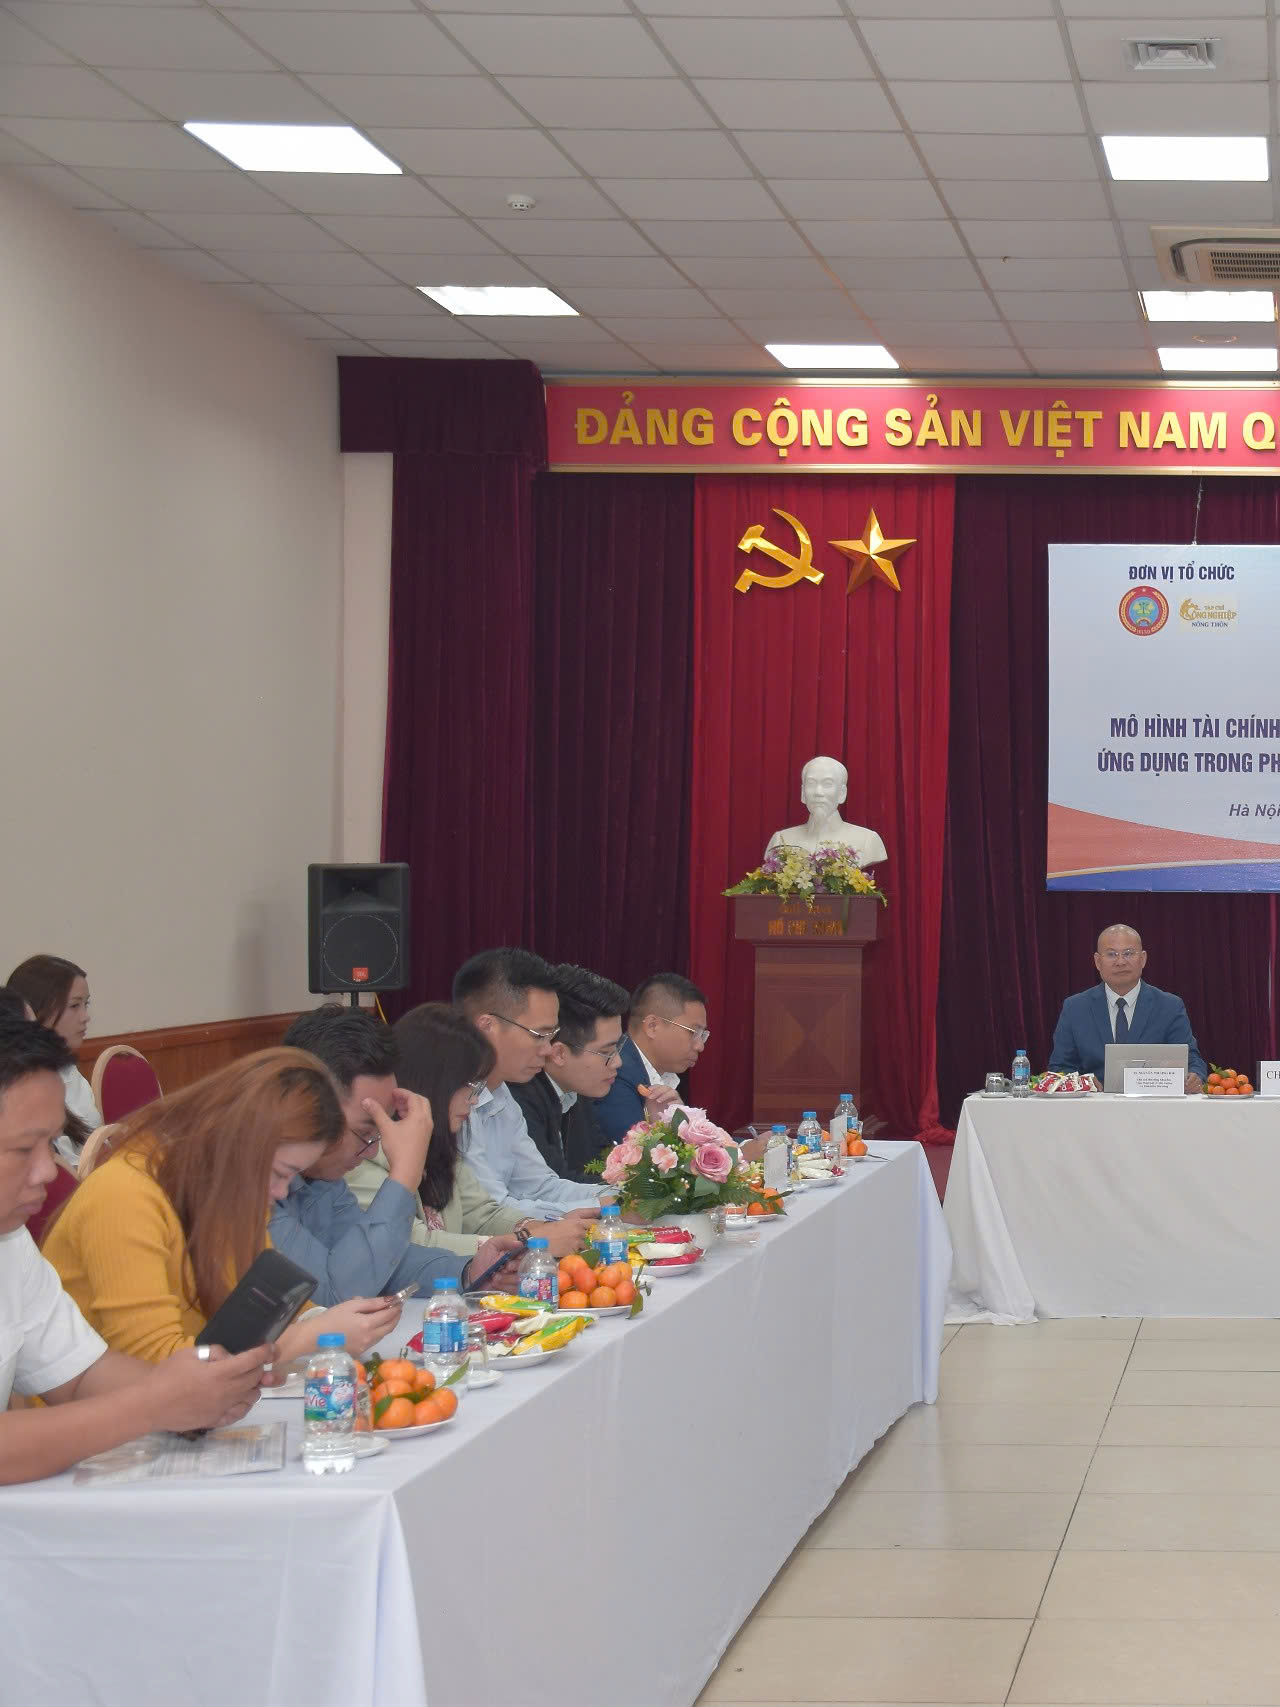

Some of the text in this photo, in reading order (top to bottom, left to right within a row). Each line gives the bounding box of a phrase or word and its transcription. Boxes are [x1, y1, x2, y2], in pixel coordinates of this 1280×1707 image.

[575, 391, 714, 446] ĐẢNG
[732, 397, 868, 457] CỘNG
[885, 394, 982, 447] SẢN
[1000, 400, 1102, 457] VIỆT
[1119, 411, 1226, 450] NAM
[1129, 561, 1235, 583] ĐƠN VỊ TỔ CHỨC
[1110, 714, 1138, 738] MÔ
[1145, 714, 1187, 738] HÌNH
[1192, 714, 1219, 738] TÀI
[1226, 715, 1280, 738] CHÍNH
[1098, 748, 1134, 772] ỨNG
[1140, 752, 1188, 776] DỤNG
[1195, 752, 1252, 773] TRONG
[1229, 804, 1249, 817] Hà
